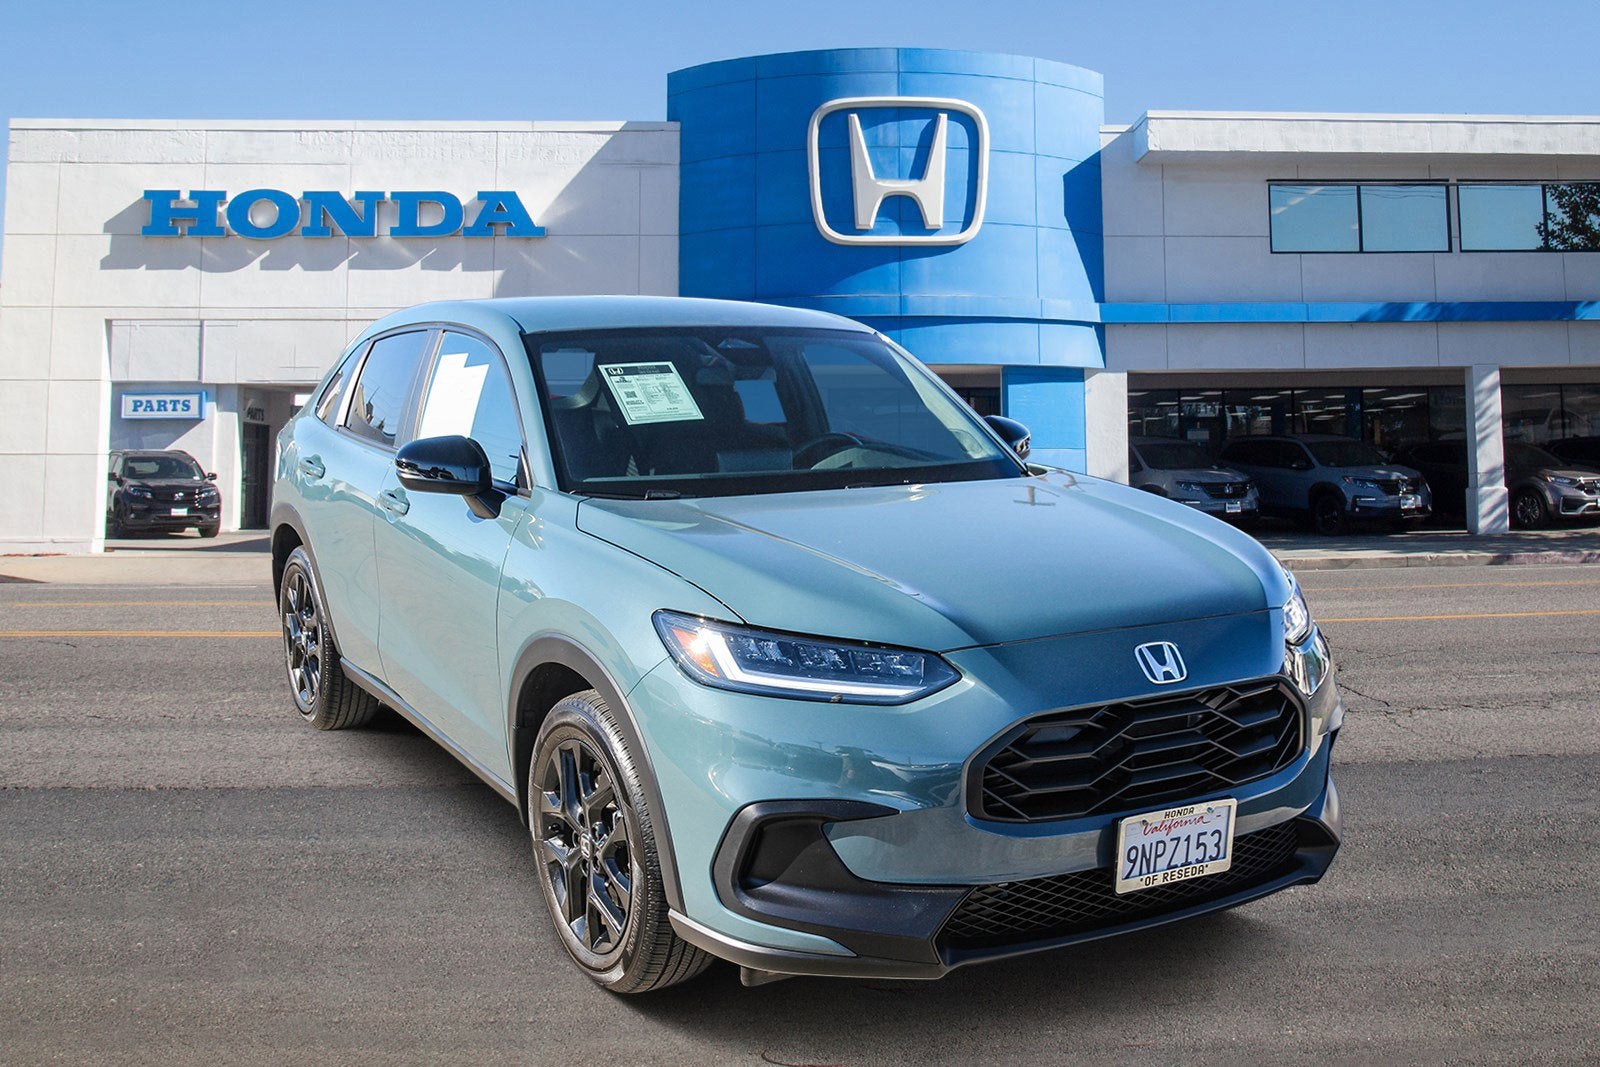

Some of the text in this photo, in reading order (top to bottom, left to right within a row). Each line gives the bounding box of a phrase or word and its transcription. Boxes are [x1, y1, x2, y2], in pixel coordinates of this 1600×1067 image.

[141, 188, 548, 240] HONDA
[132, 399, 191, 412] PARTS
[1164, 807, 1195, 819] HONDA
[1142, 815, 1211, 836] California
[1123, 829, 1222, 880] 9NPZ153
[1144, 865, 1205, 887] OF RESEDA
